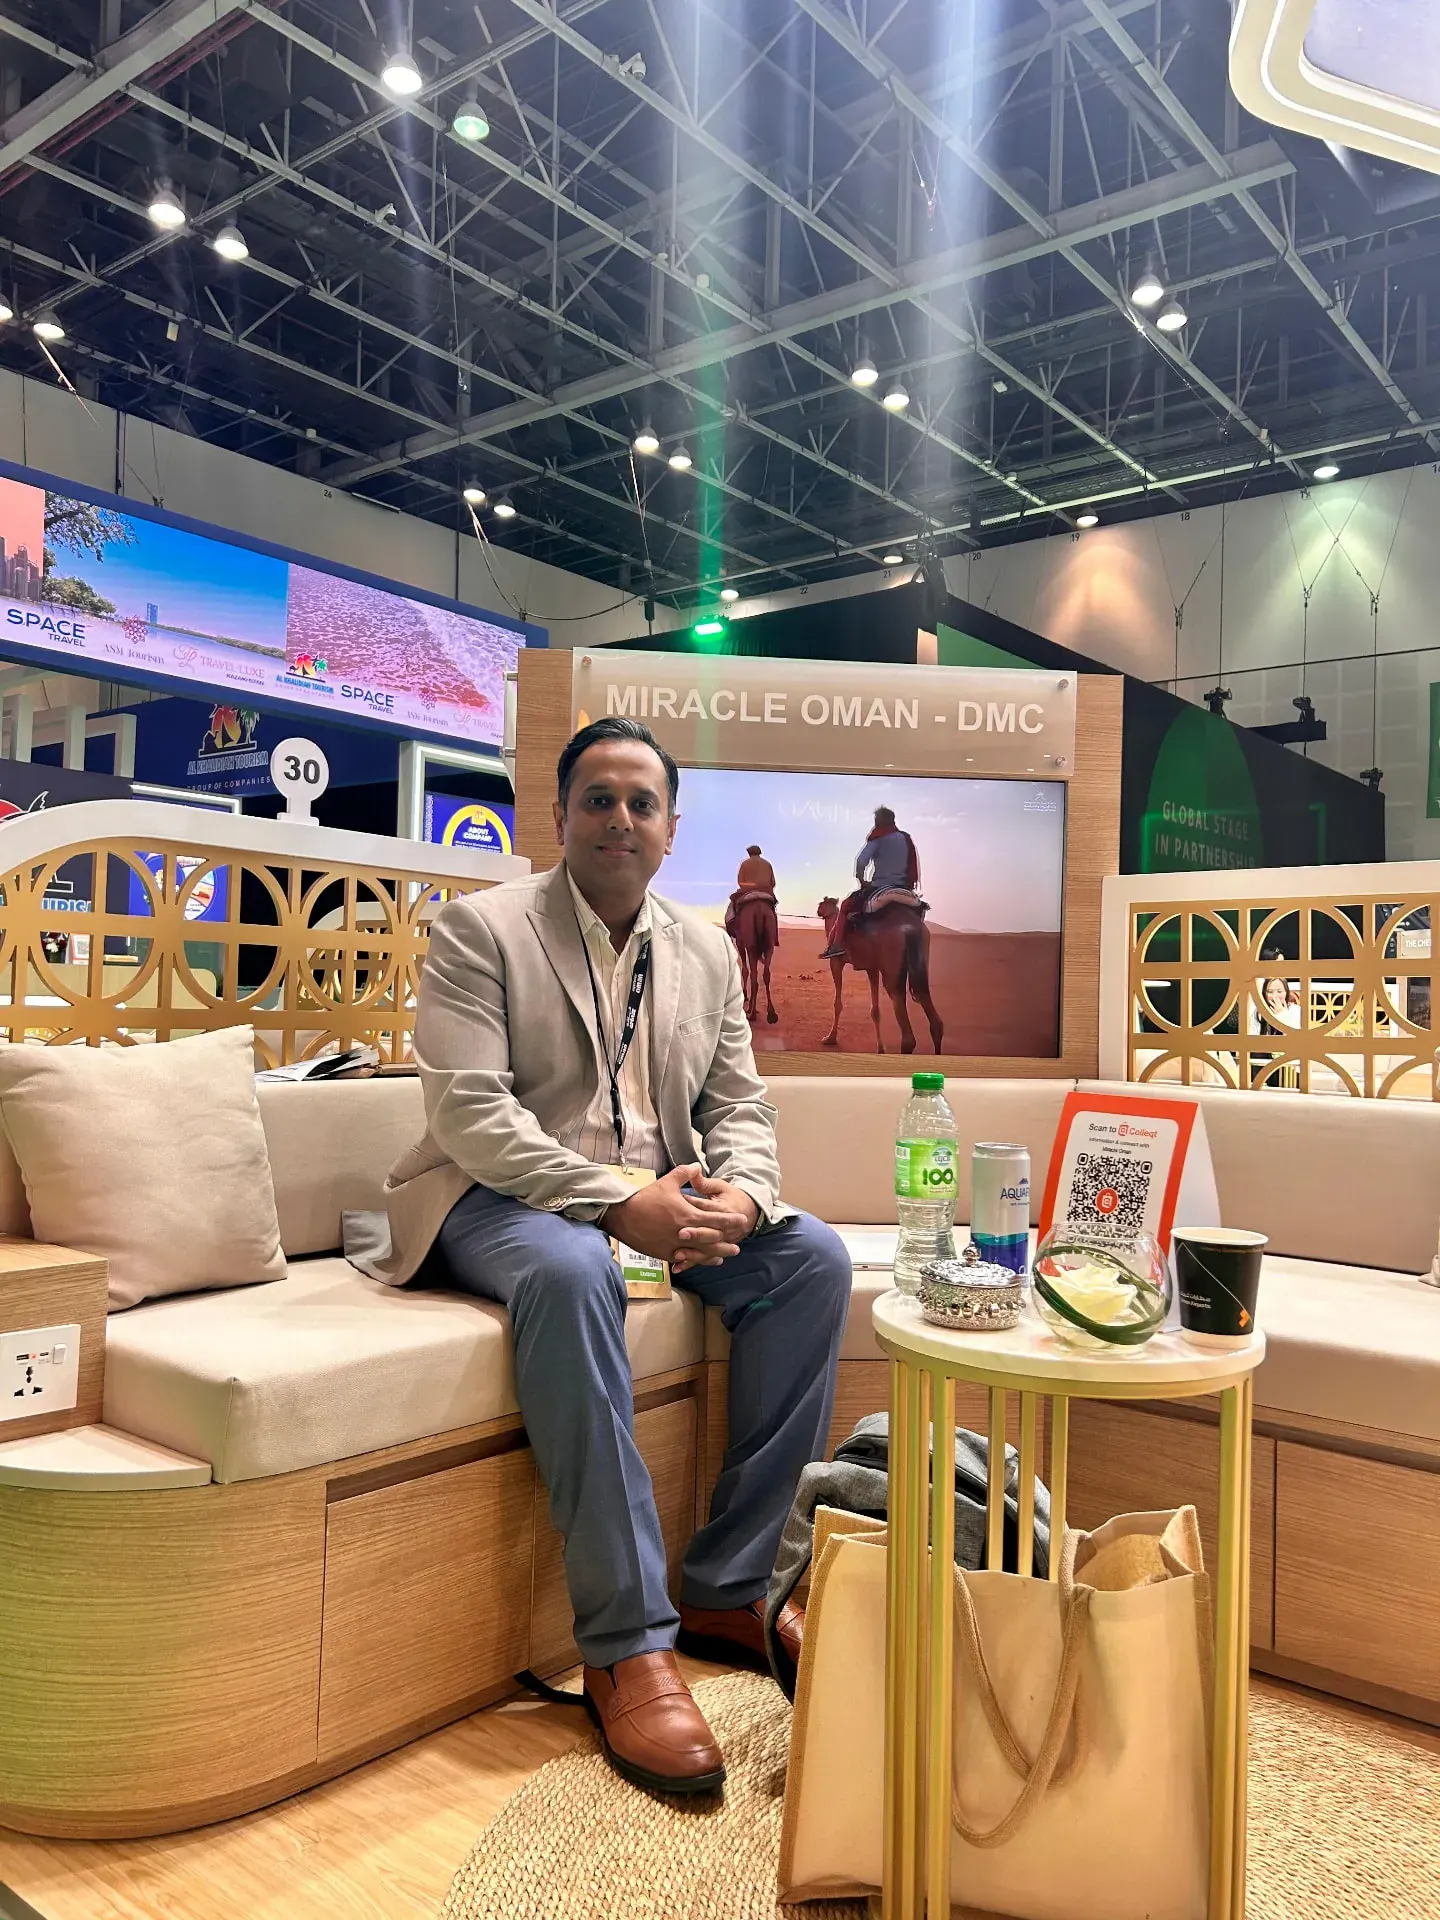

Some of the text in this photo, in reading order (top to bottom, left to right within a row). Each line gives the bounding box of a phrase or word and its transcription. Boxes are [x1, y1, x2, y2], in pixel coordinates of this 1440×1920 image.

[1180, 512, 1191, 521] 18
[972, 552, 982, 561] 20
[883, 570, 891, 578] 21
[6, 608, 86, 640] SPACE
[48, 632, 86, 648] TRAVEL
[200, 655, 236, 674] TRAVEL
[341, 684, 395, 708] SPACE
[368, 703, 395, 715] TRAVEL
[606, 684, 1044, 734] MIRACLE OMAN - DMC
[187, 760, 197, 776] AL
[235, 751, 269, 769] TOURISM
[283, 755, 321, 784] 30
[224, 776, 271, 788] COMPANIES
[1163, 801, 1249, 840] GLOBAL STAGE
[463, 832, 493, 843] COMPANY
[468, 827, 490, 835] ABOUT
[1155, 832, 1256, 869] IN PARTNERSHIP
[1405, 940, 1417, 948] THE
[1088, 1123, 1107, 1132] Scan
[1129, 1127, 1158, 1139] Colleqt
